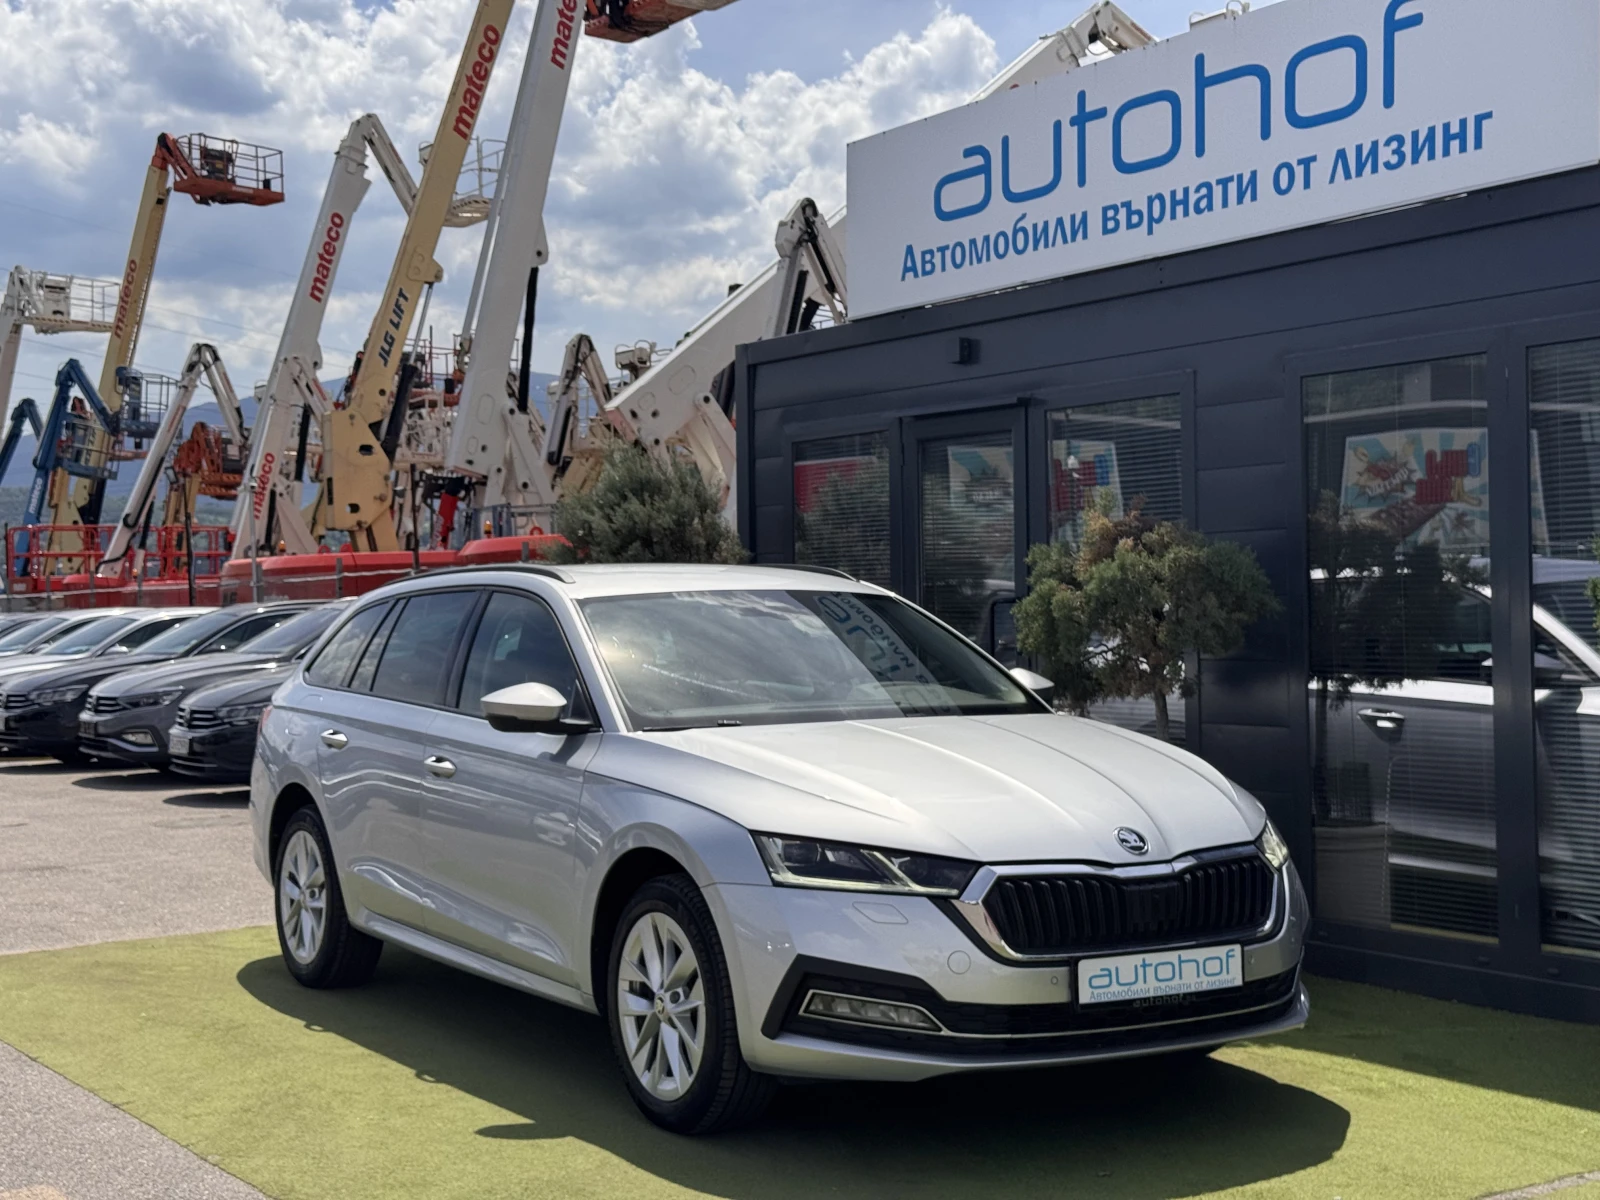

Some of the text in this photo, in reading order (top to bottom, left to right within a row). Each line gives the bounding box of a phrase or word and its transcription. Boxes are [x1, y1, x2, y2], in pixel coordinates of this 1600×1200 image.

[453, 24, 500, 140] mateco
[933, 0, 1424, 222] autohof
[901, 110, 1493, 281] Автомобили върнати от лизинг
[114, 259, 137, 339] mateco
[309, 212, 344, 303] mateco
[378, 287, 409, 368] JLG LIFT
[1088, 948, 1236, 989] autohof
[1089, 986, 1151, 1001] Автомобили
[1153, 980, 1193, 996] върнати
[1194, 979, 1205, 990] от
